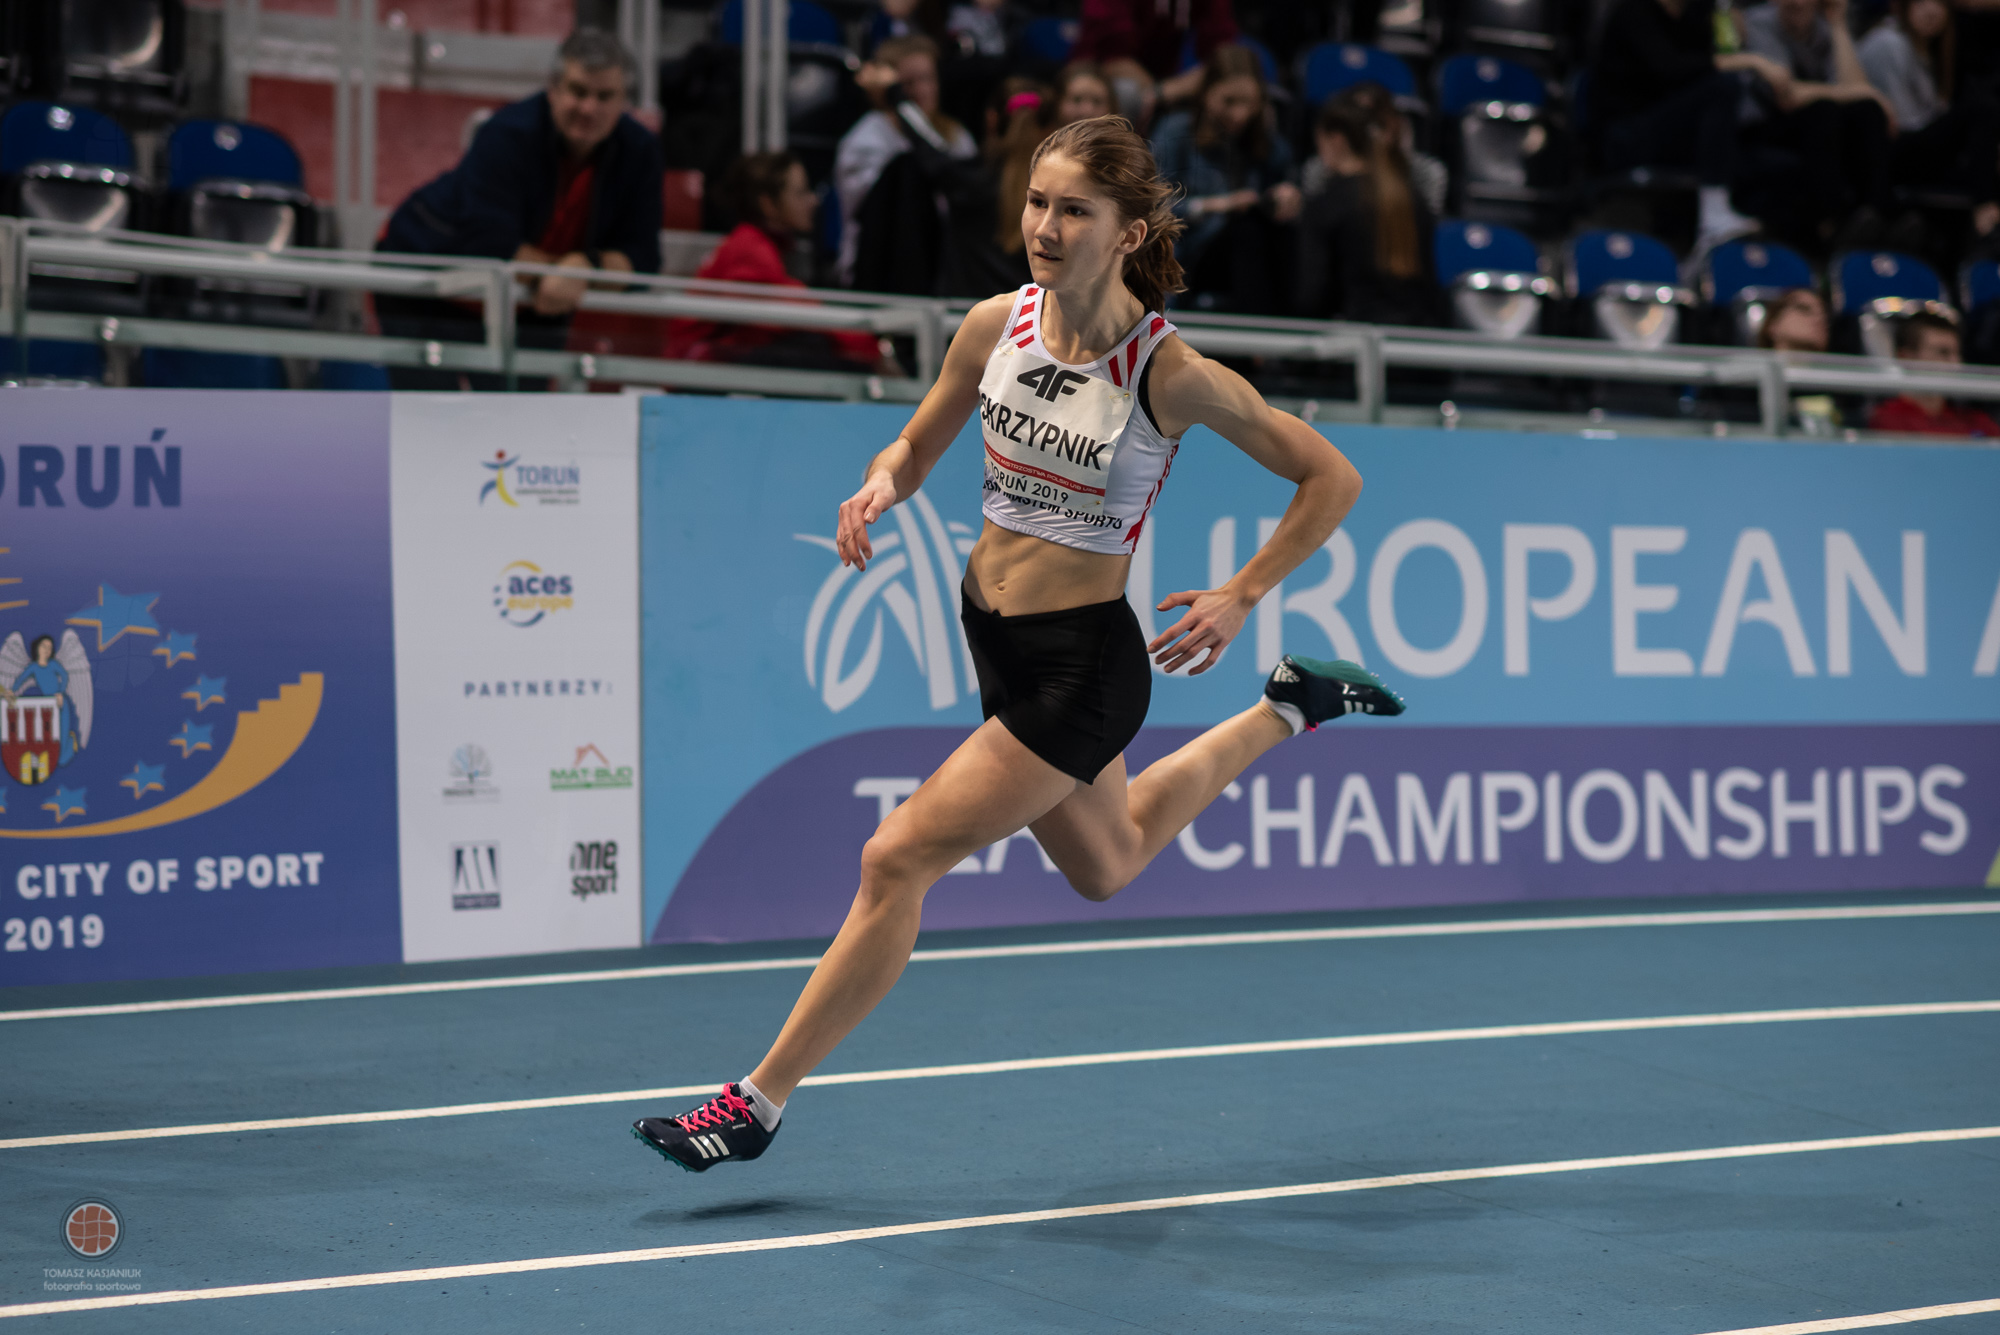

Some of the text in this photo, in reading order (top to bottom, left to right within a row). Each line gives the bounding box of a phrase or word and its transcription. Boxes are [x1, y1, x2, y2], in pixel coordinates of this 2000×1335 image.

[1016, 363, 1091, 403] 4F
[981, 392, 1108, 471] SKRZYPNIK
[0, 428, 183, 509] RUŃ
[1031, 481, 1069, 504] 2019
[508, 574, 574, 597] aces
[1129, 516, 1928, 679] UROPEAN
[1178, 764, 1971, 871] CHAMPIONSHIPS
[16, 852, 325, 900] CITY OF SPORT
[3, 913, 105, 952] 2019
